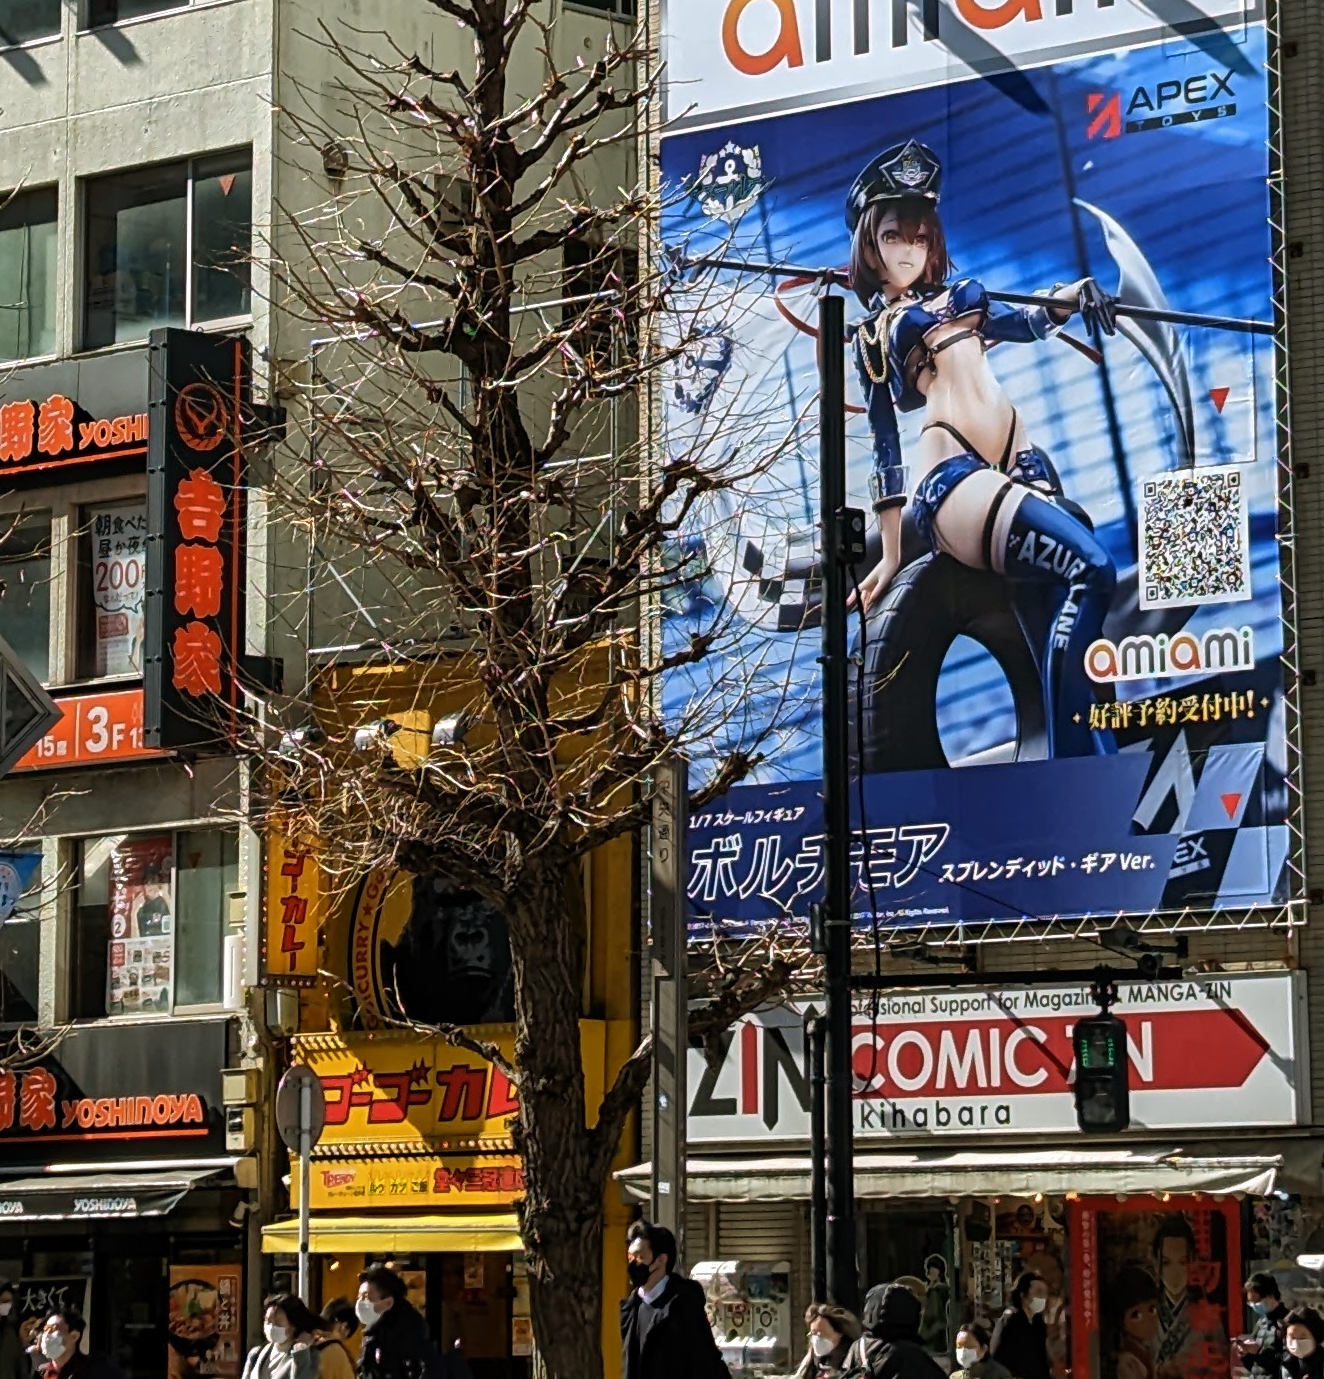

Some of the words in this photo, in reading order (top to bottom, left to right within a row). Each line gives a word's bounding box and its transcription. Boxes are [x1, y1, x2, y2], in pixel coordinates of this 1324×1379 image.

[1126, 68, 1237, 115] APEX
[98, 536, 146, 560] 昼か夜
[96, 559, 145, 593] 200
[172, 466, 227, 697] 吉野家
[1086, 628, 1253, 680] amiami
[1087, 690, 1255, 731] 好評予約受付中！
[85, 706, 126, 753] 3F
[689, 813, 711, 829] 1/7
[713, 806, 806, 827] スケールフィギュア
[1120, 852, 1157, 871] Ver.
[930, 993, 992, 1017] Support
[998, 991, 1018, 1010] for
[1024, 988, 1098, 1011] Magazin
[1128, 982, 1232, 1004] MANGA-ZIN
[62, 1092, 205, 1130] YOSHINOYA
[73, 1197, 138, 1213] YOSHINOYA
